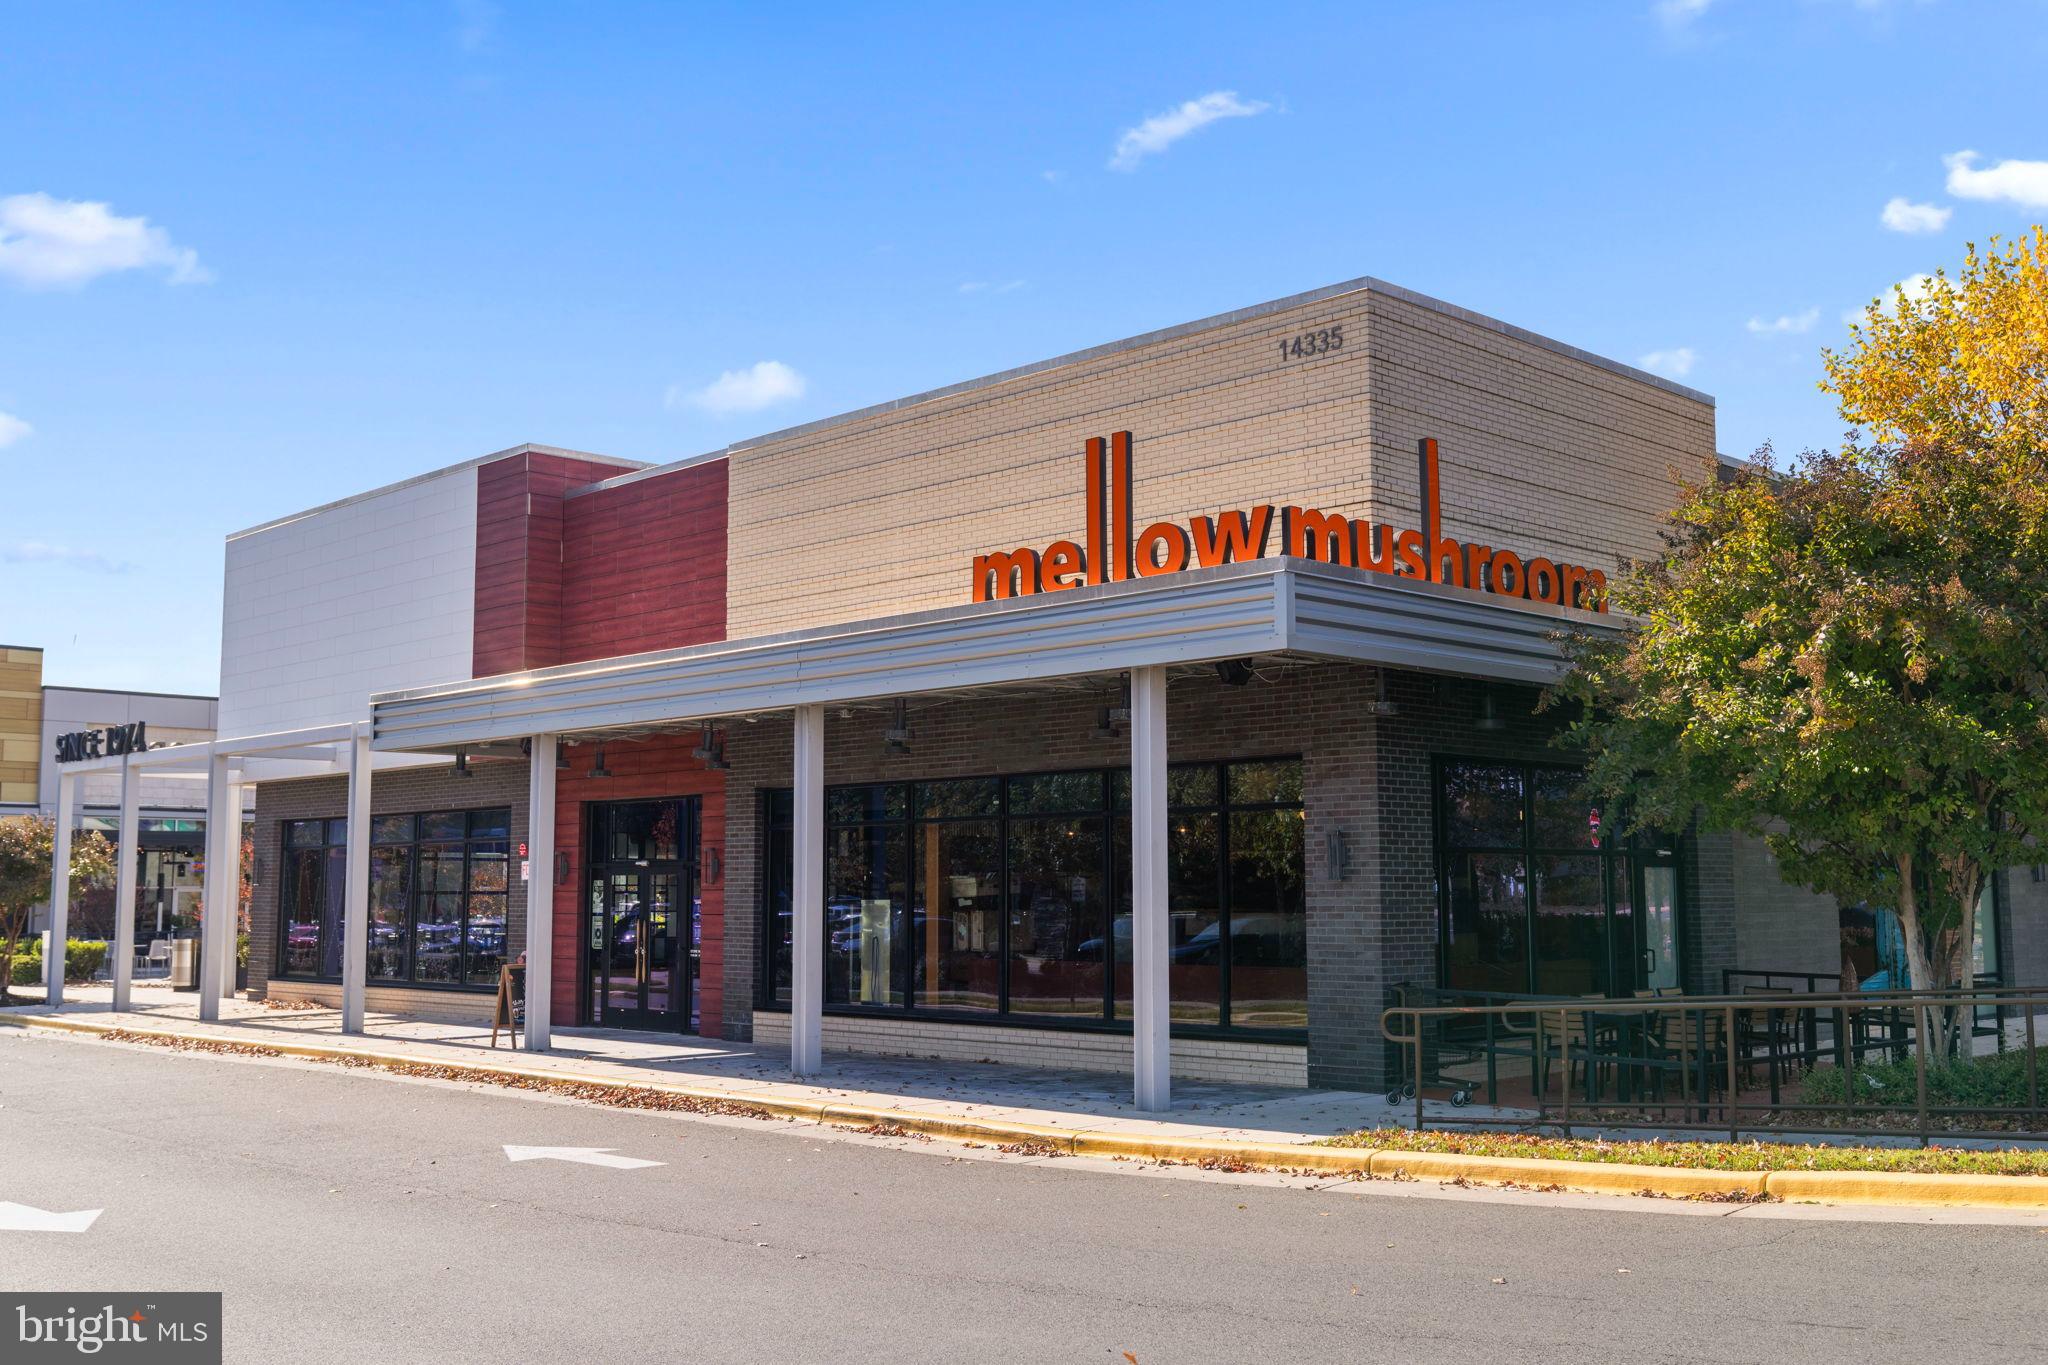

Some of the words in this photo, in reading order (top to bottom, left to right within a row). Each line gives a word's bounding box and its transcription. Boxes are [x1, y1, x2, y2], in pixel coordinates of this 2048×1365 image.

[1279, 325, 1343, 361] 14335
[973, 430, 1275, 603] mellow
[1281, 437, 1609, 614] mushroom
